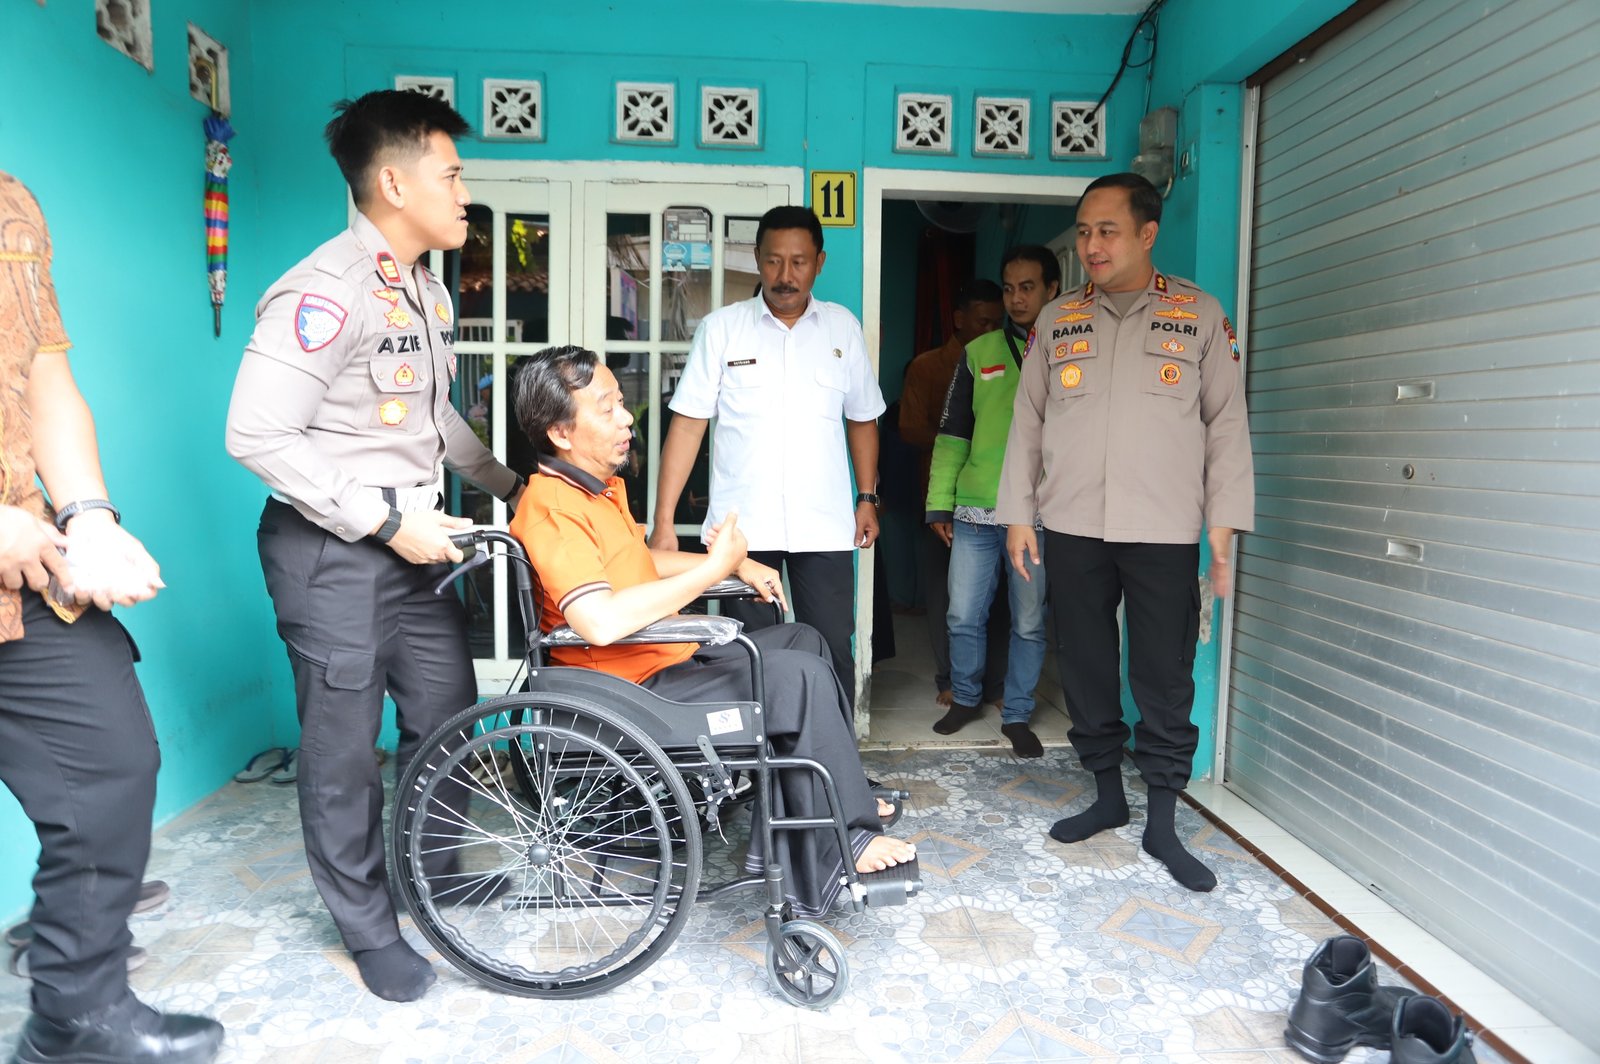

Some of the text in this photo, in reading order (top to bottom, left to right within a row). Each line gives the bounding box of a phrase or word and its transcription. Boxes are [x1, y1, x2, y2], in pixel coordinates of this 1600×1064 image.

[820, 179, 846, 218] 11
[1052, 323, 1094, 341] RAMA
[1150, 321, 1198, 338] POLRI
